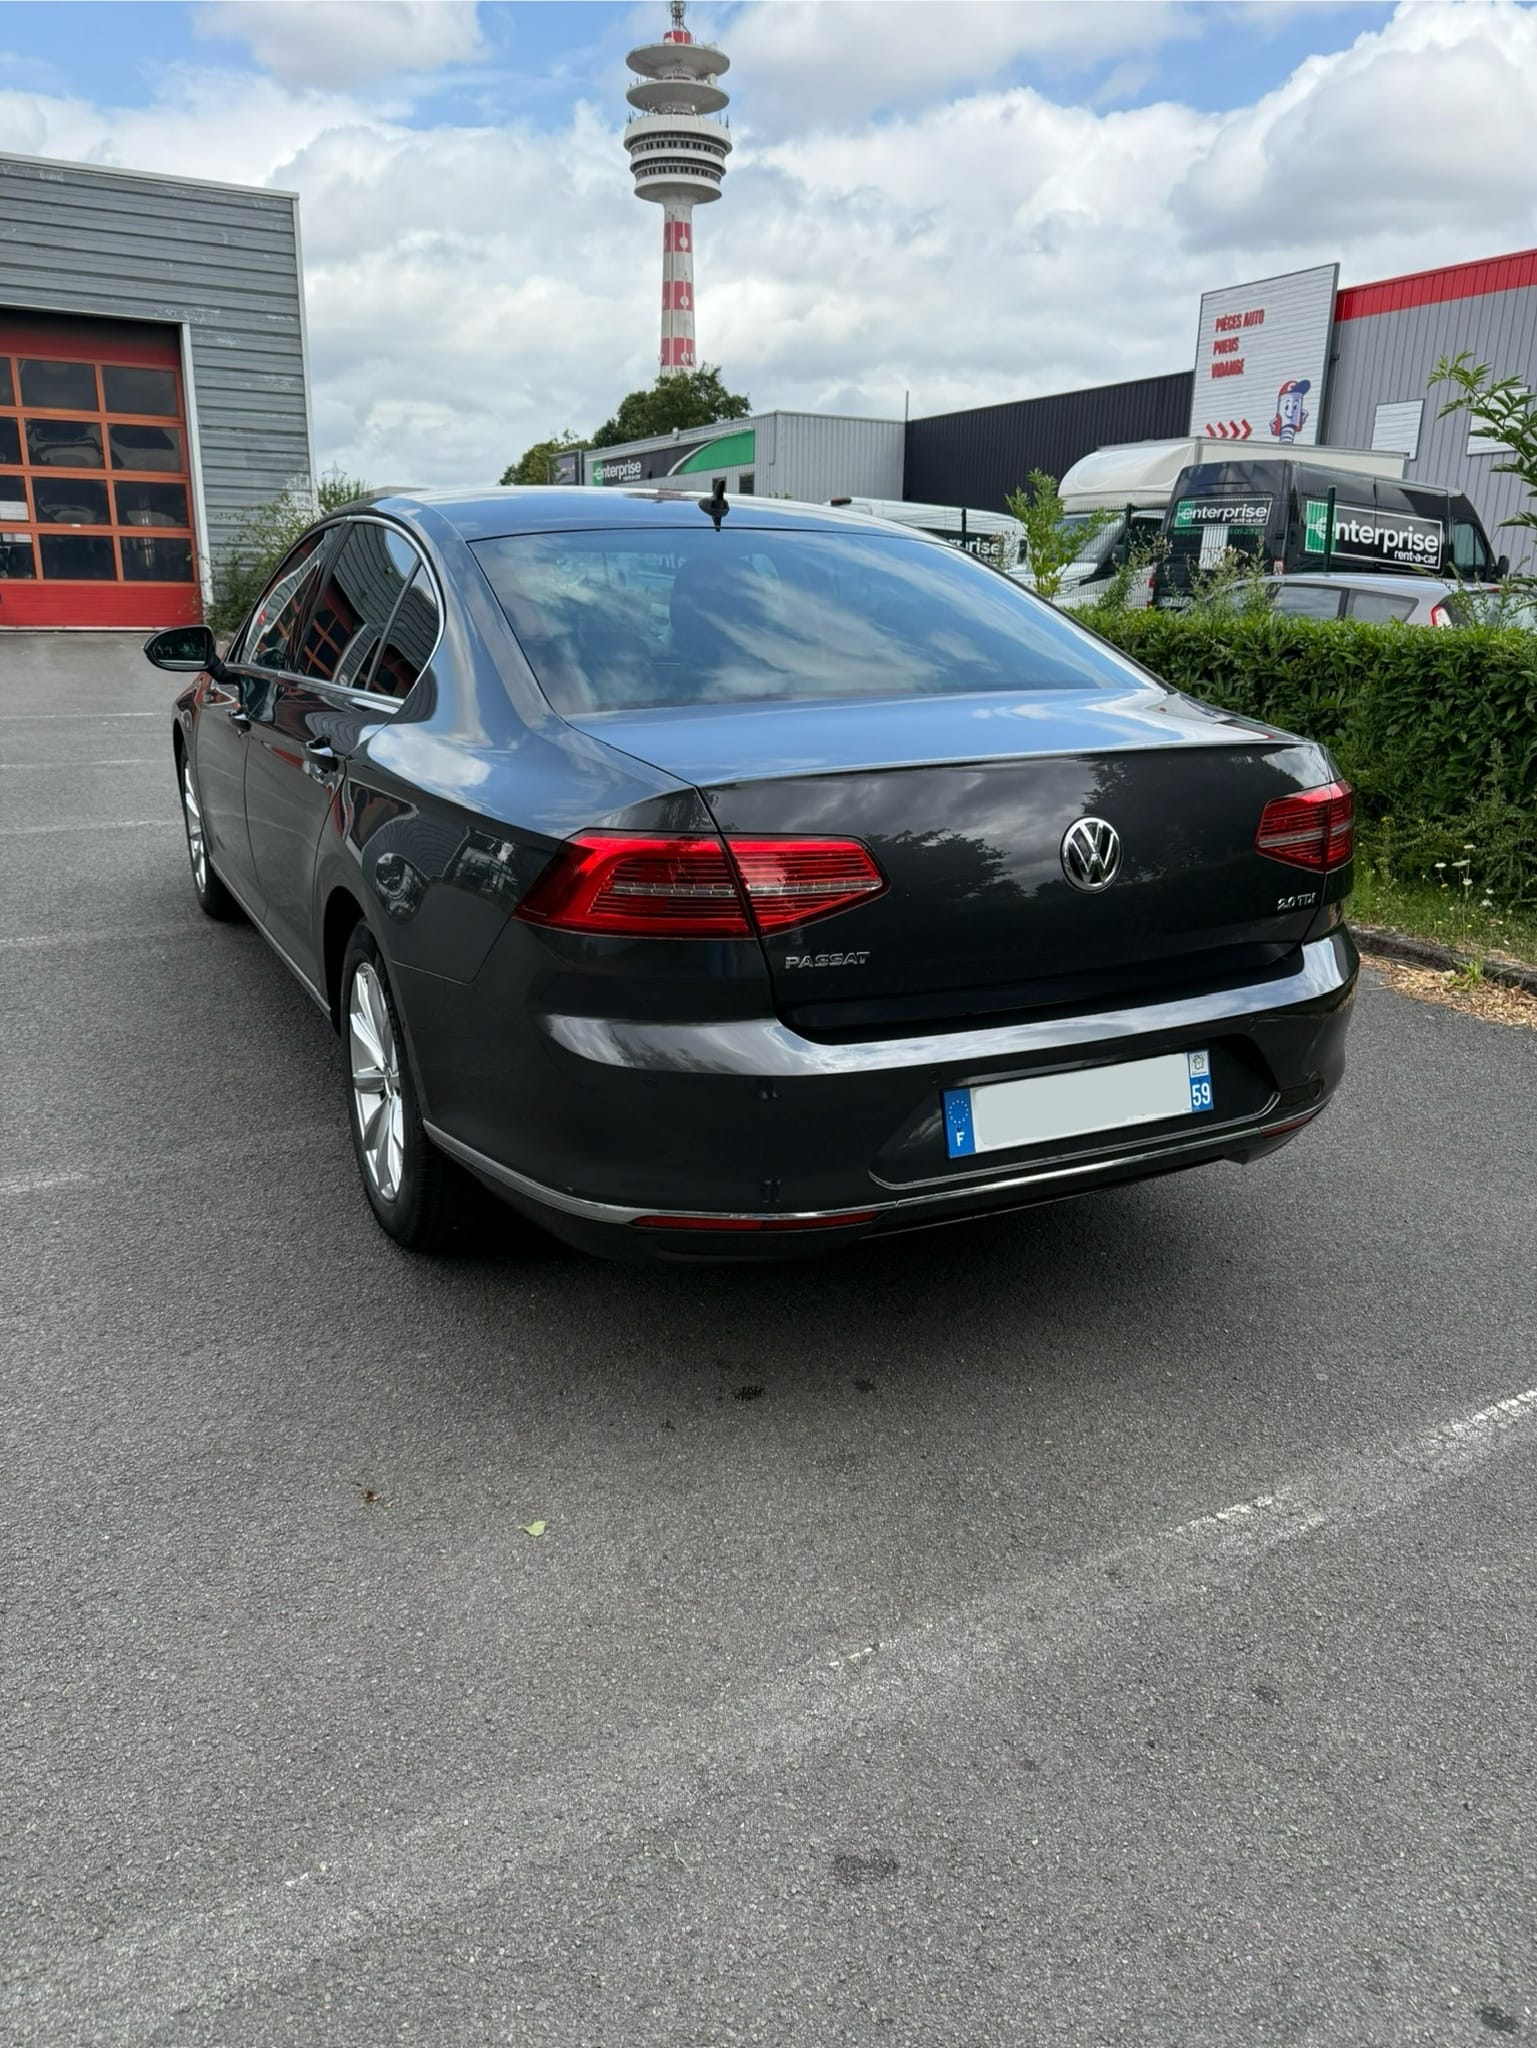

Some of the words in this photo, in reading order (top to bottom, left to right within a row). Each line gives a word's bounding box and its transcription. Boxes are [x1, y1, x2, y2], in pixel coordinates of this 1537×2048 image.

[1243, 309, 1265, 328] AUTO
[1213, 337, 1239, 356] PNEUS
[593, 459, 642, 480] enterprise
[1179, 503, 1268, 522] enterprise
[1394, 550, 1438, 565] rent-a-car
[1297, 892, 1317, 906] TDI
[784, 951, 871, 969] PASSAT
[1191, 1082, 1211, 1107] 59
[956, 1131, 966, 1147] F
